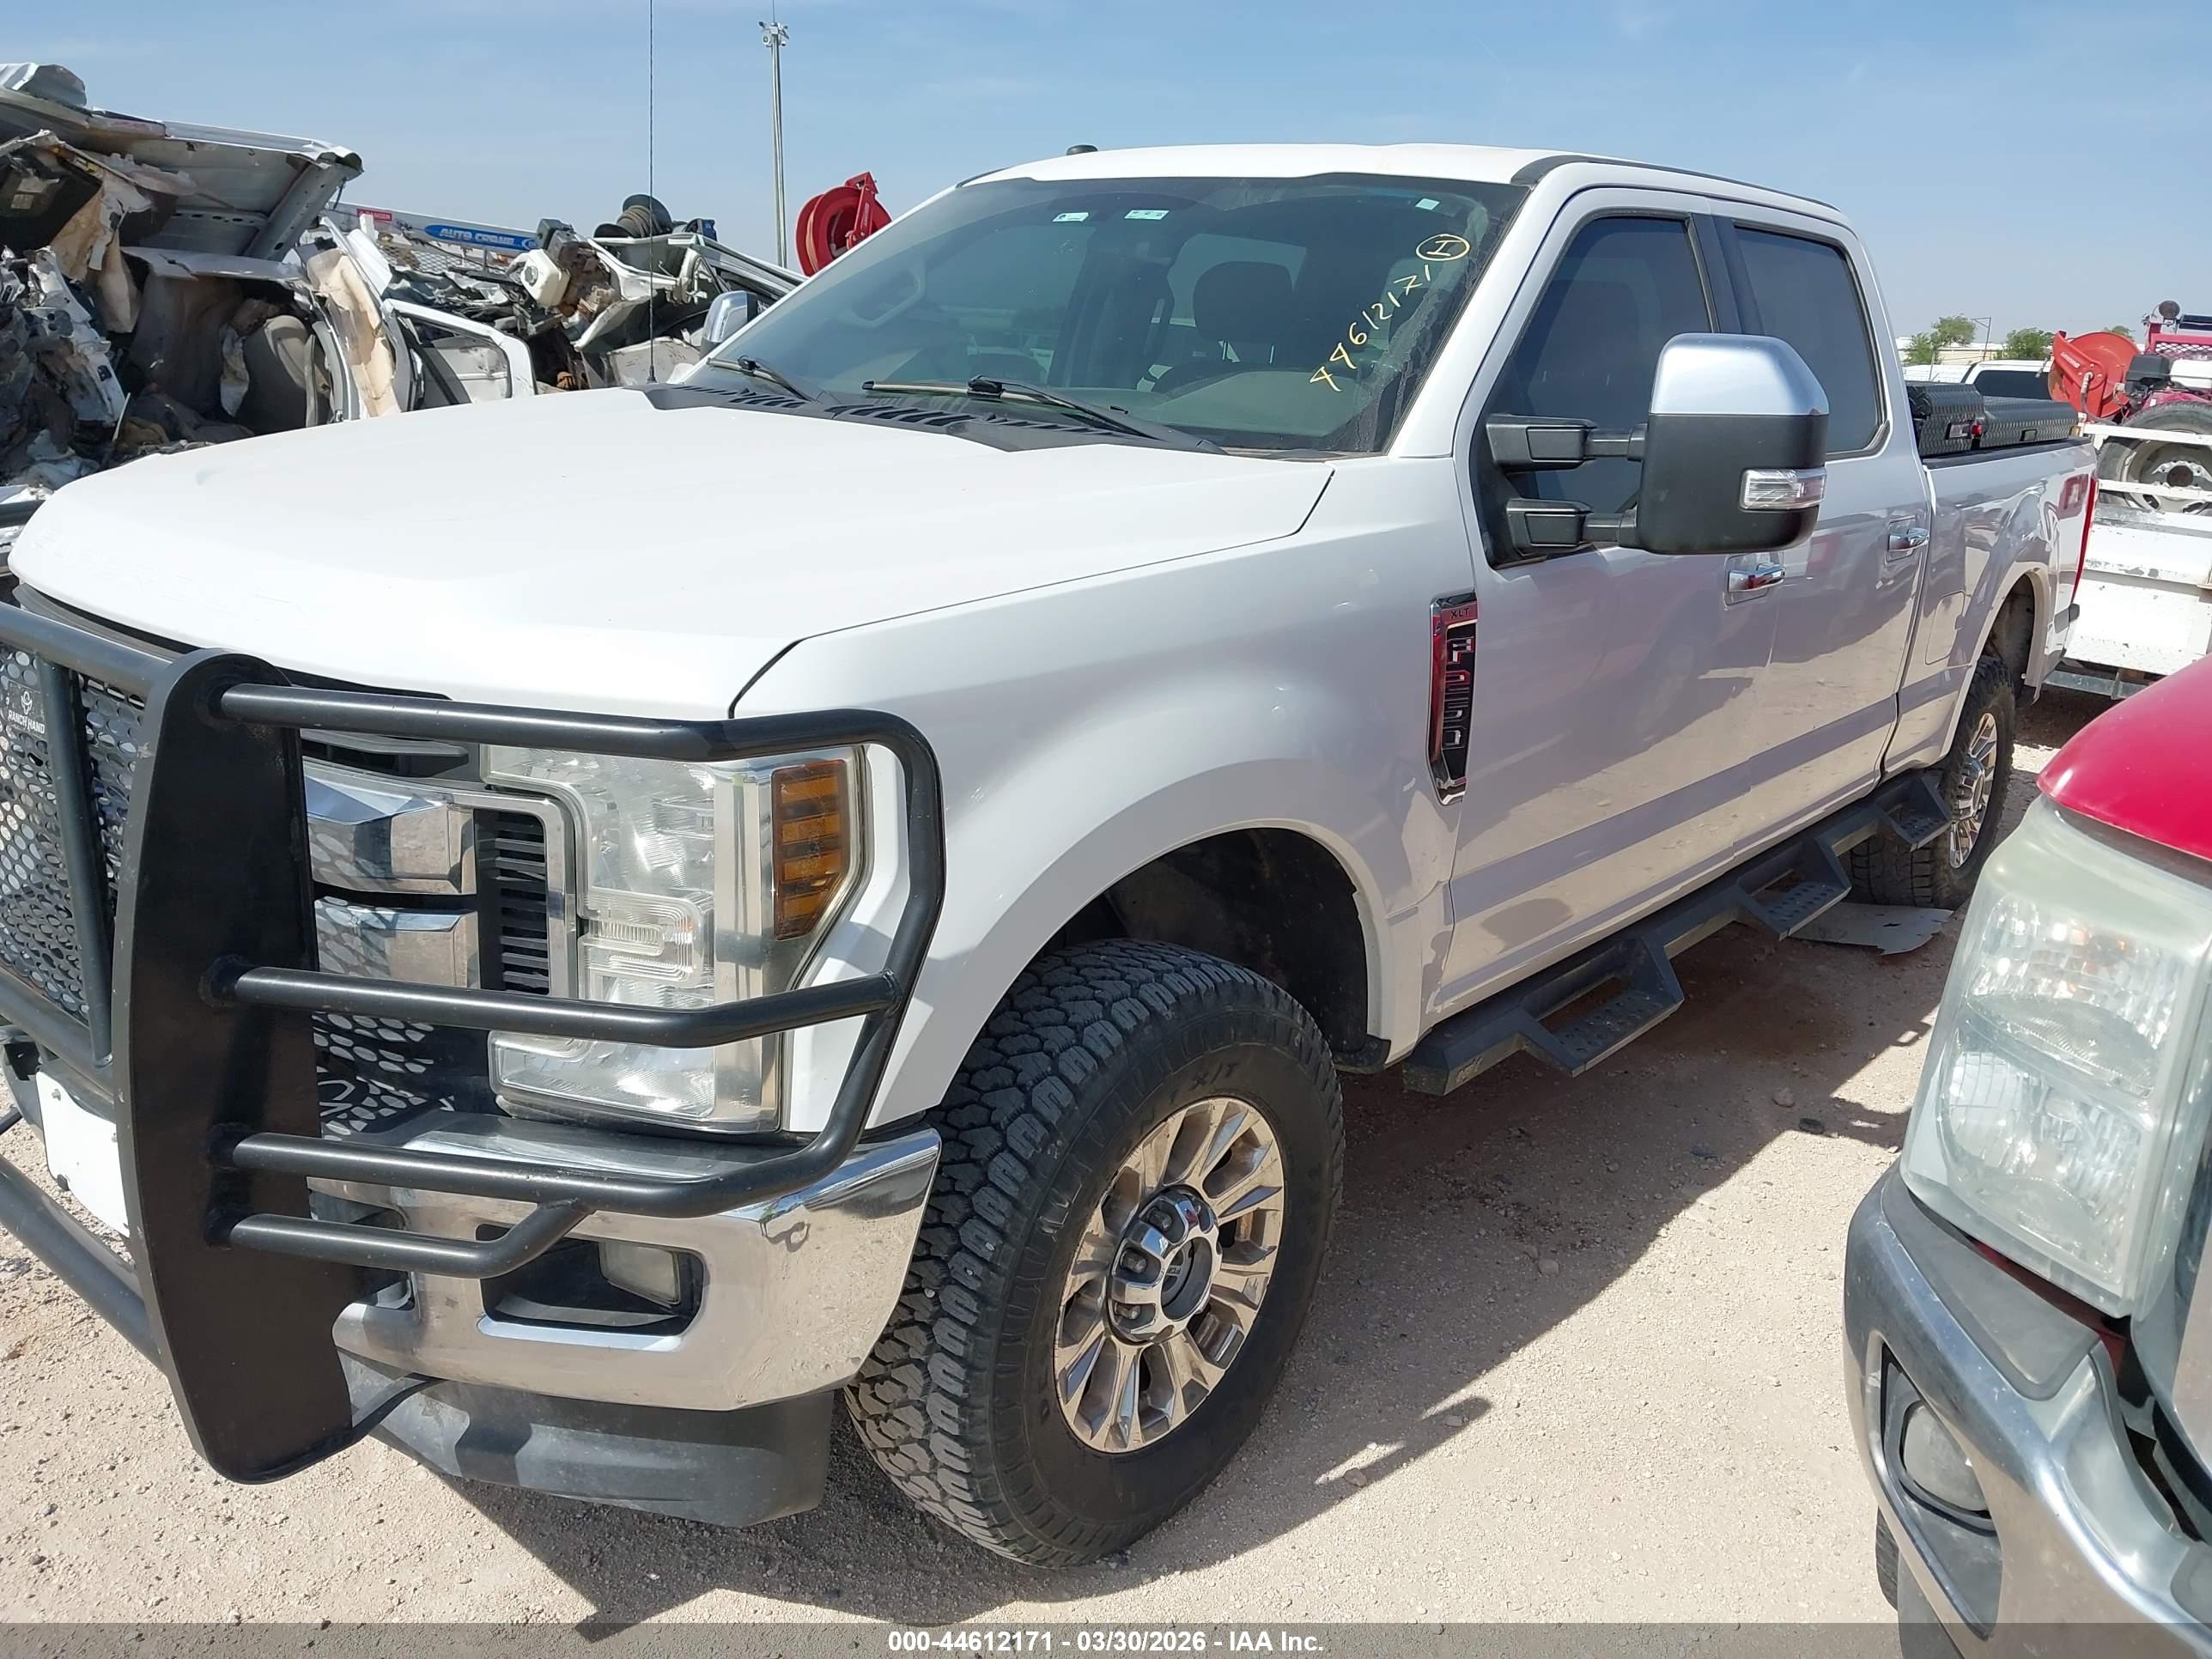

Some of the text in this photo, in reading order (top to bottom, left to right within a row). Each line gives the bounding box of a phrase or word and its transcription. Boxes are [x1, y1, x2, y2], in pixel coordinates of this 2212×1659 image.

[440, 228, 472, 240] AUTO
[1310, 264, 1431, 392] 44612171
[1450, 607, 1470, 619] XLT
[8, 709, 46, 734] RANCH HAND
